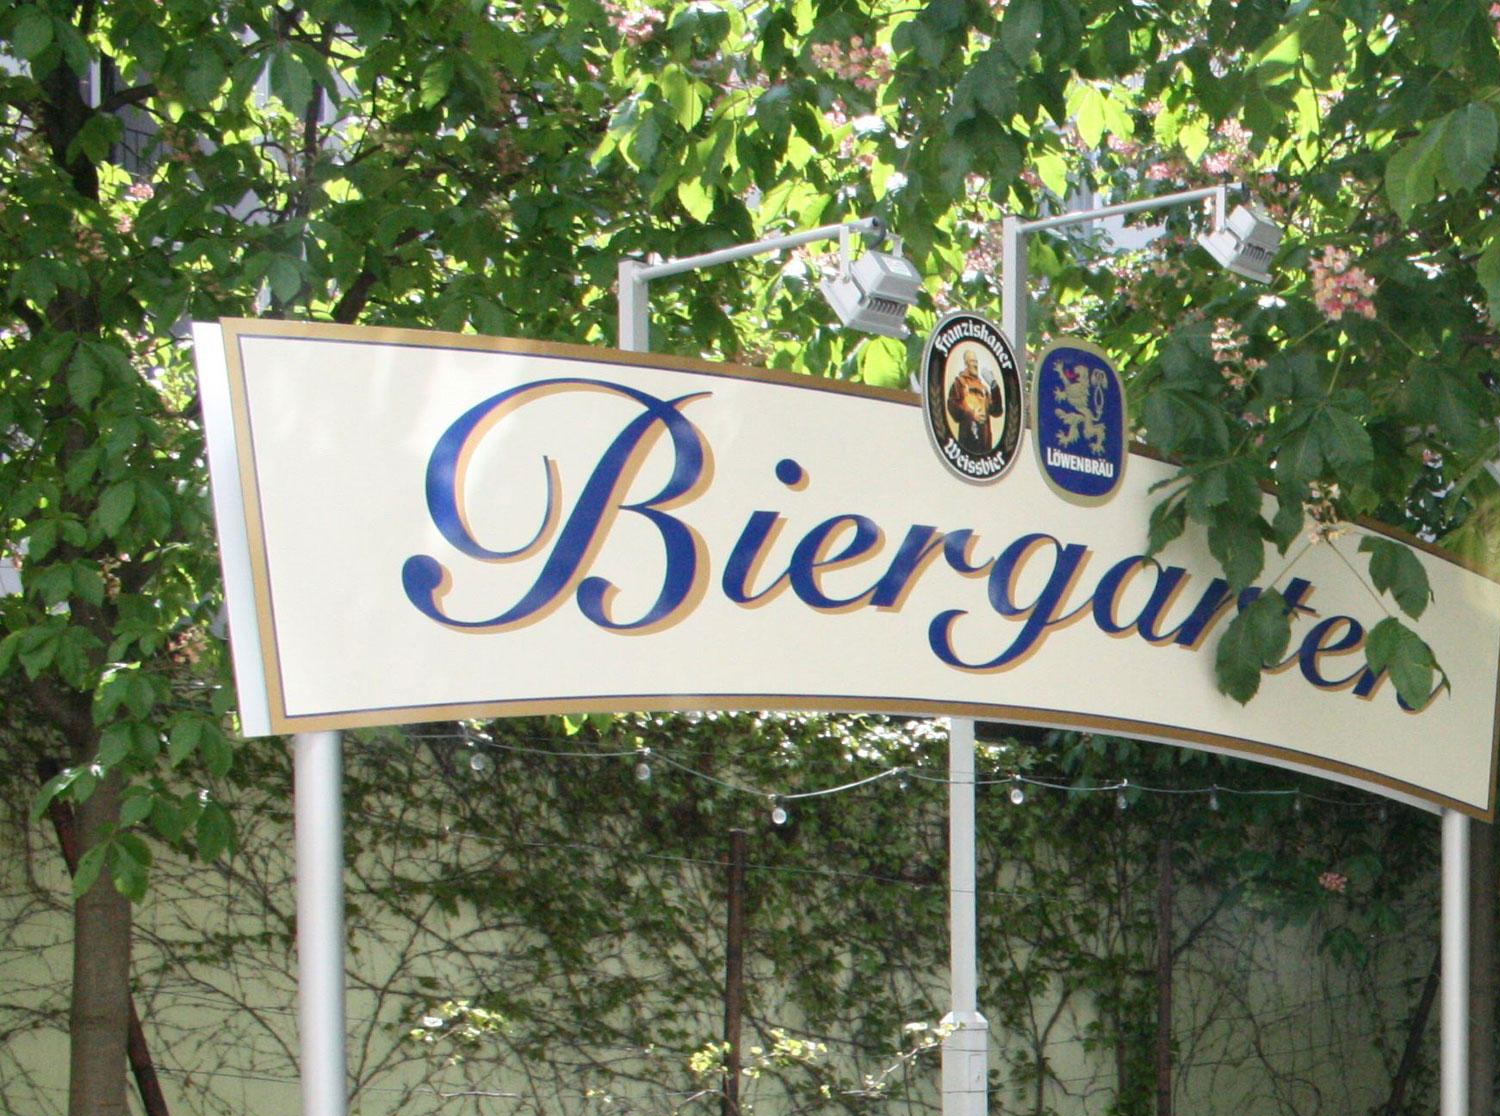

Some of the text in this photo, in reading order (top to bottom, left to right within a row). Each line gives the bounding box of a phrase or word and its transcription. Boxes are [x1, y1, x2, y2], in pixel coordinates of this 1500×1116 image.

[934, 319, 1013, 371] Franziskaner
[944, 437, 1006, 477] Weissbier
[1046, 447, 1114, 478] LÖWENBRÄU
